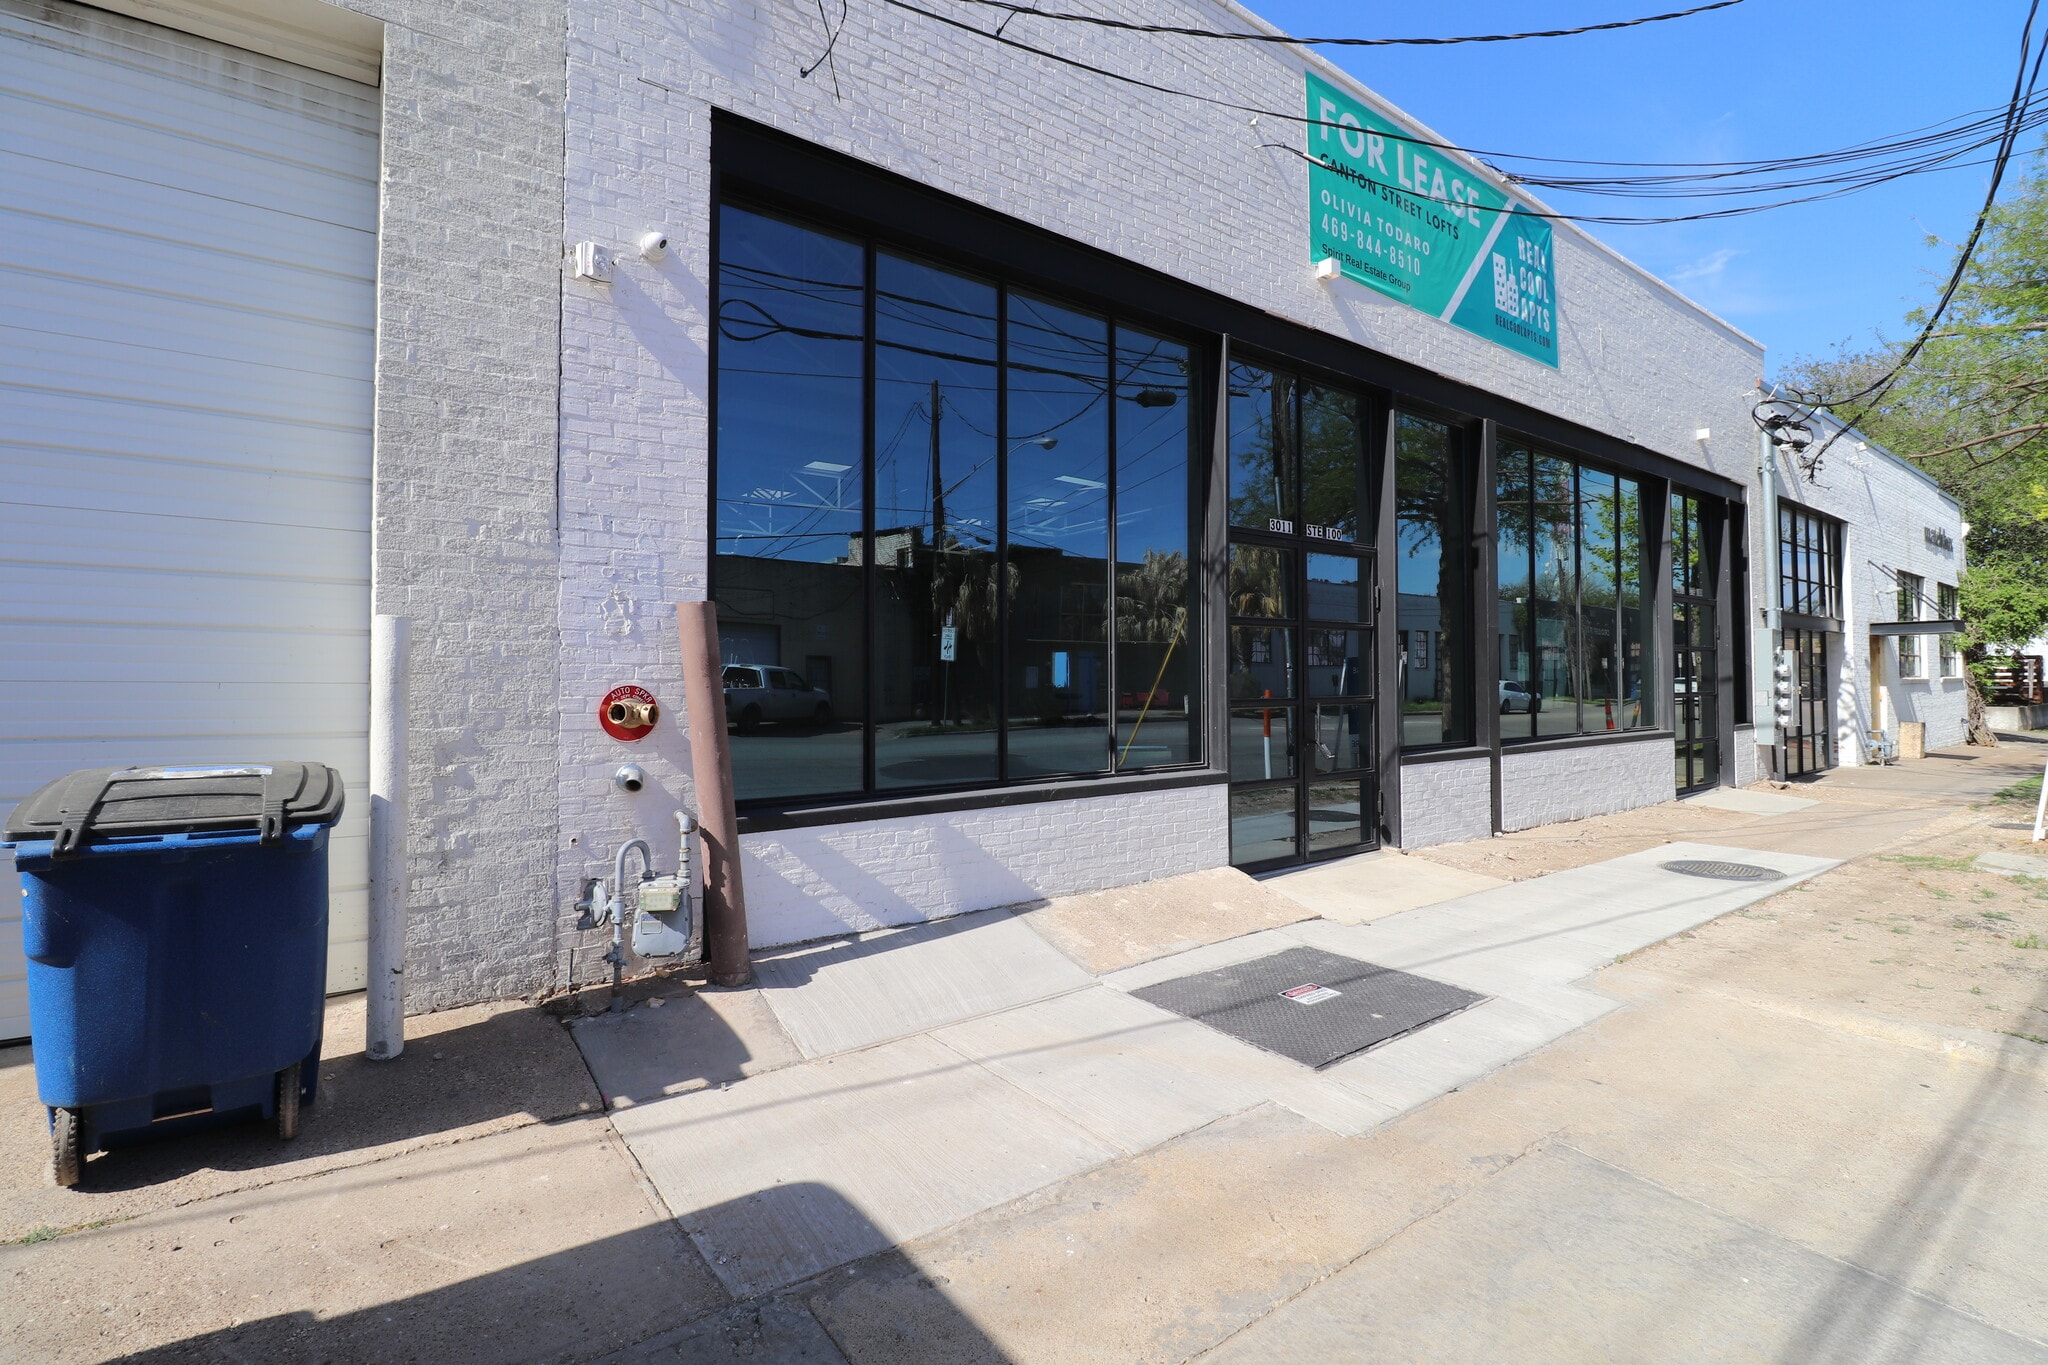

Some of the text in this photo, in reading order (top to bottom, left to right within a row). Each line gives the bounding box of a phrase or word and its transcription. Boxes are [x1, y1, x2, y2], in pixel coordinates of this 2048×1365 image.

[1320, 96, 1481, 228] FOR LEASE
[1321, 189, 1430, 255] OLIVIA TODARO
[1381, 187, 1422, 220] STREET
[1426, 210, 1459, 240] LOFTS
[1321, 213, 1420, 276] 469-844-8510
[1322, 243, 1411, 292] Spirit Real Estate Group
[1520, 267, 1549, 304] COOL
[1521, 297, 1550, 332] APTS
[1270, 520, 1342, 540] 3011 STE 100
[611, 686, 631, 700] AUTO
